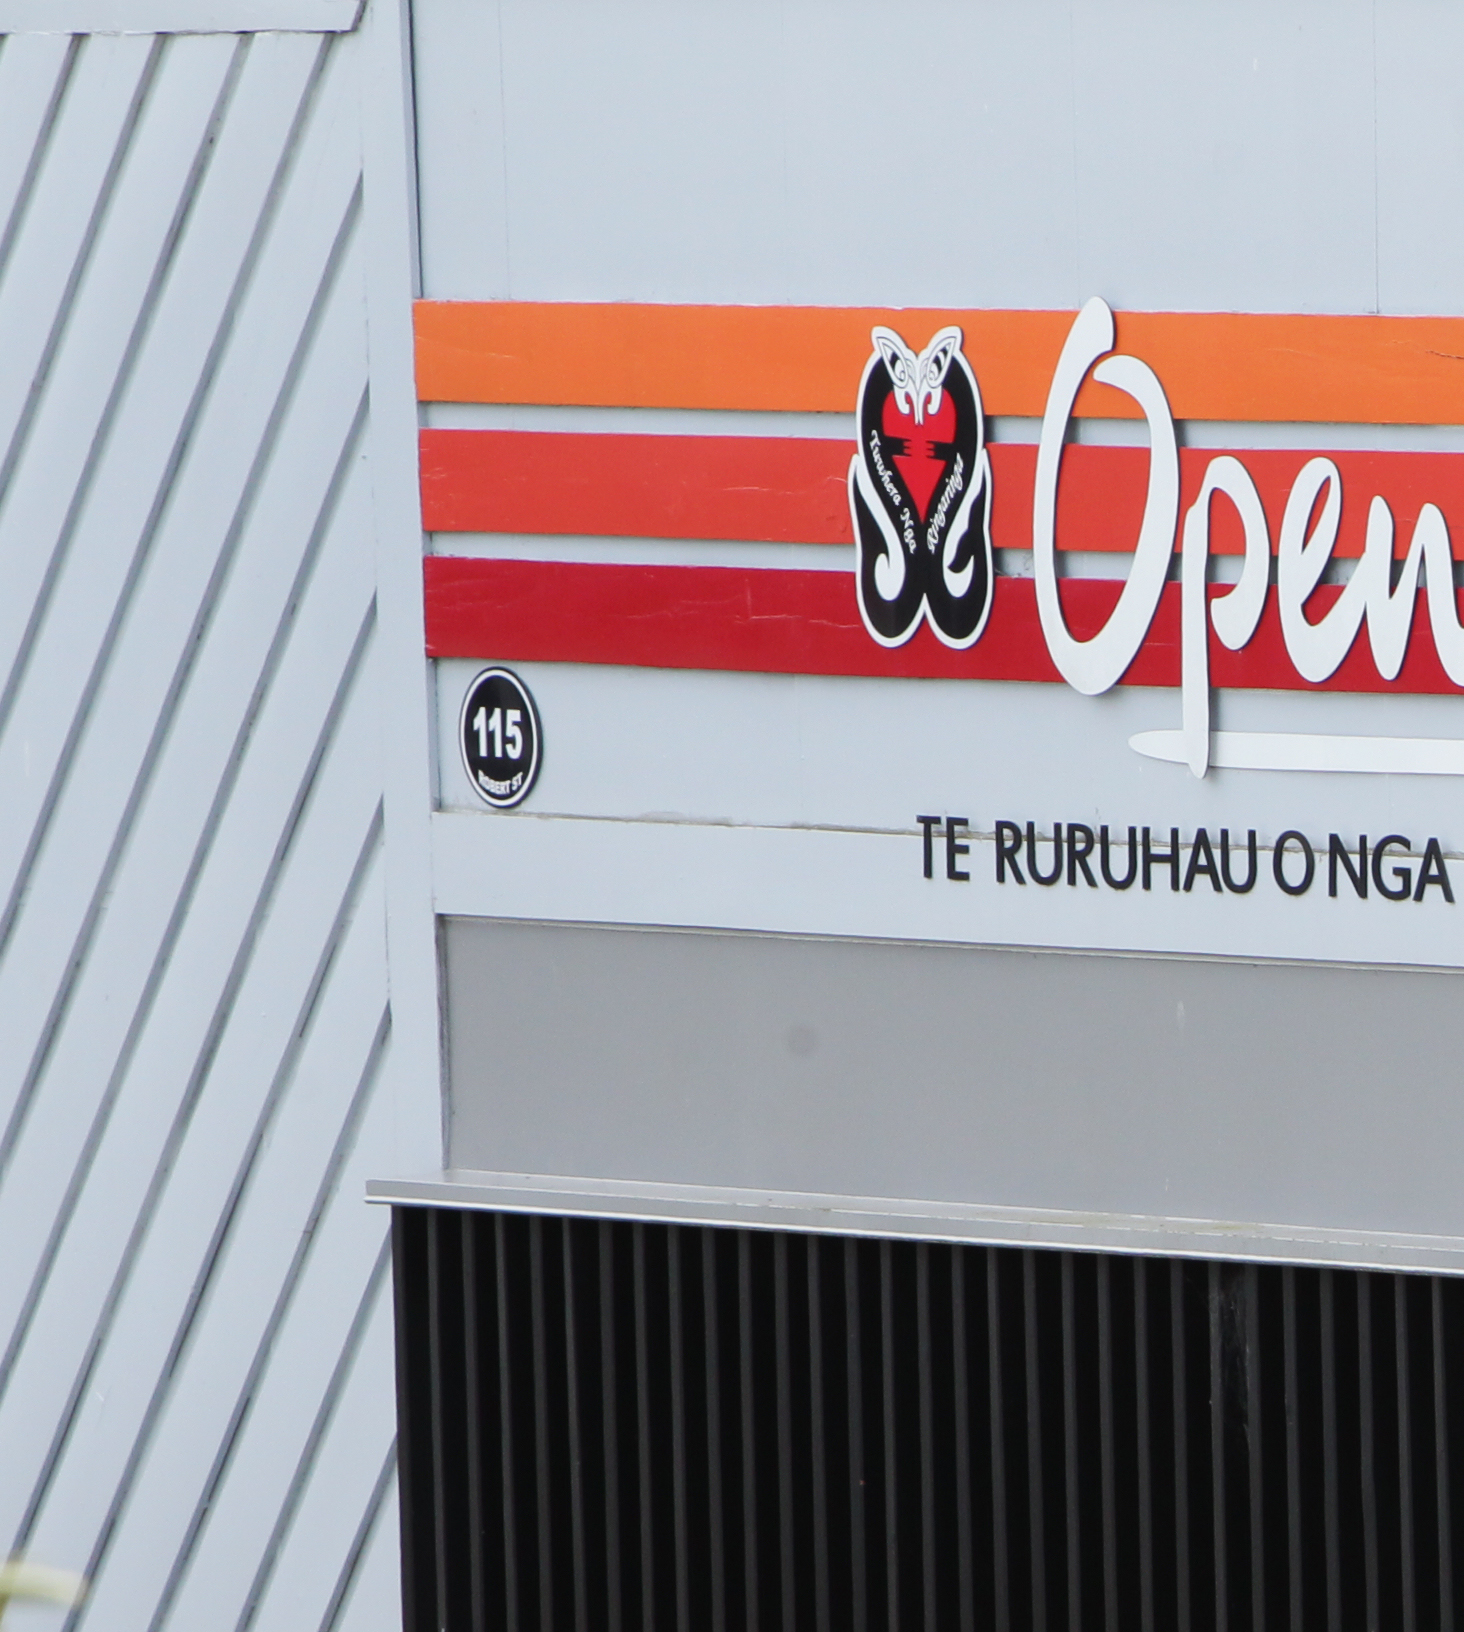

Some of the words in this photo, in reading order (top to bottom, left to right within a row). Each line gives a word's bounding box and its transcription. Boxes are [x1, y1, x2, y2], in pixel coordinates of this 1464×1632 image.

[473, 706, 523, 760] 115
[478, 769, 511, 795] ROBERT
[511, 771, 523, 791] ST
[916, 815, 970, 882] TE
[994, 819, 1258, 895] RURUHAU
[1272, 830, 1315, 897] O
[1327, 832, 1455, 904] NGA
